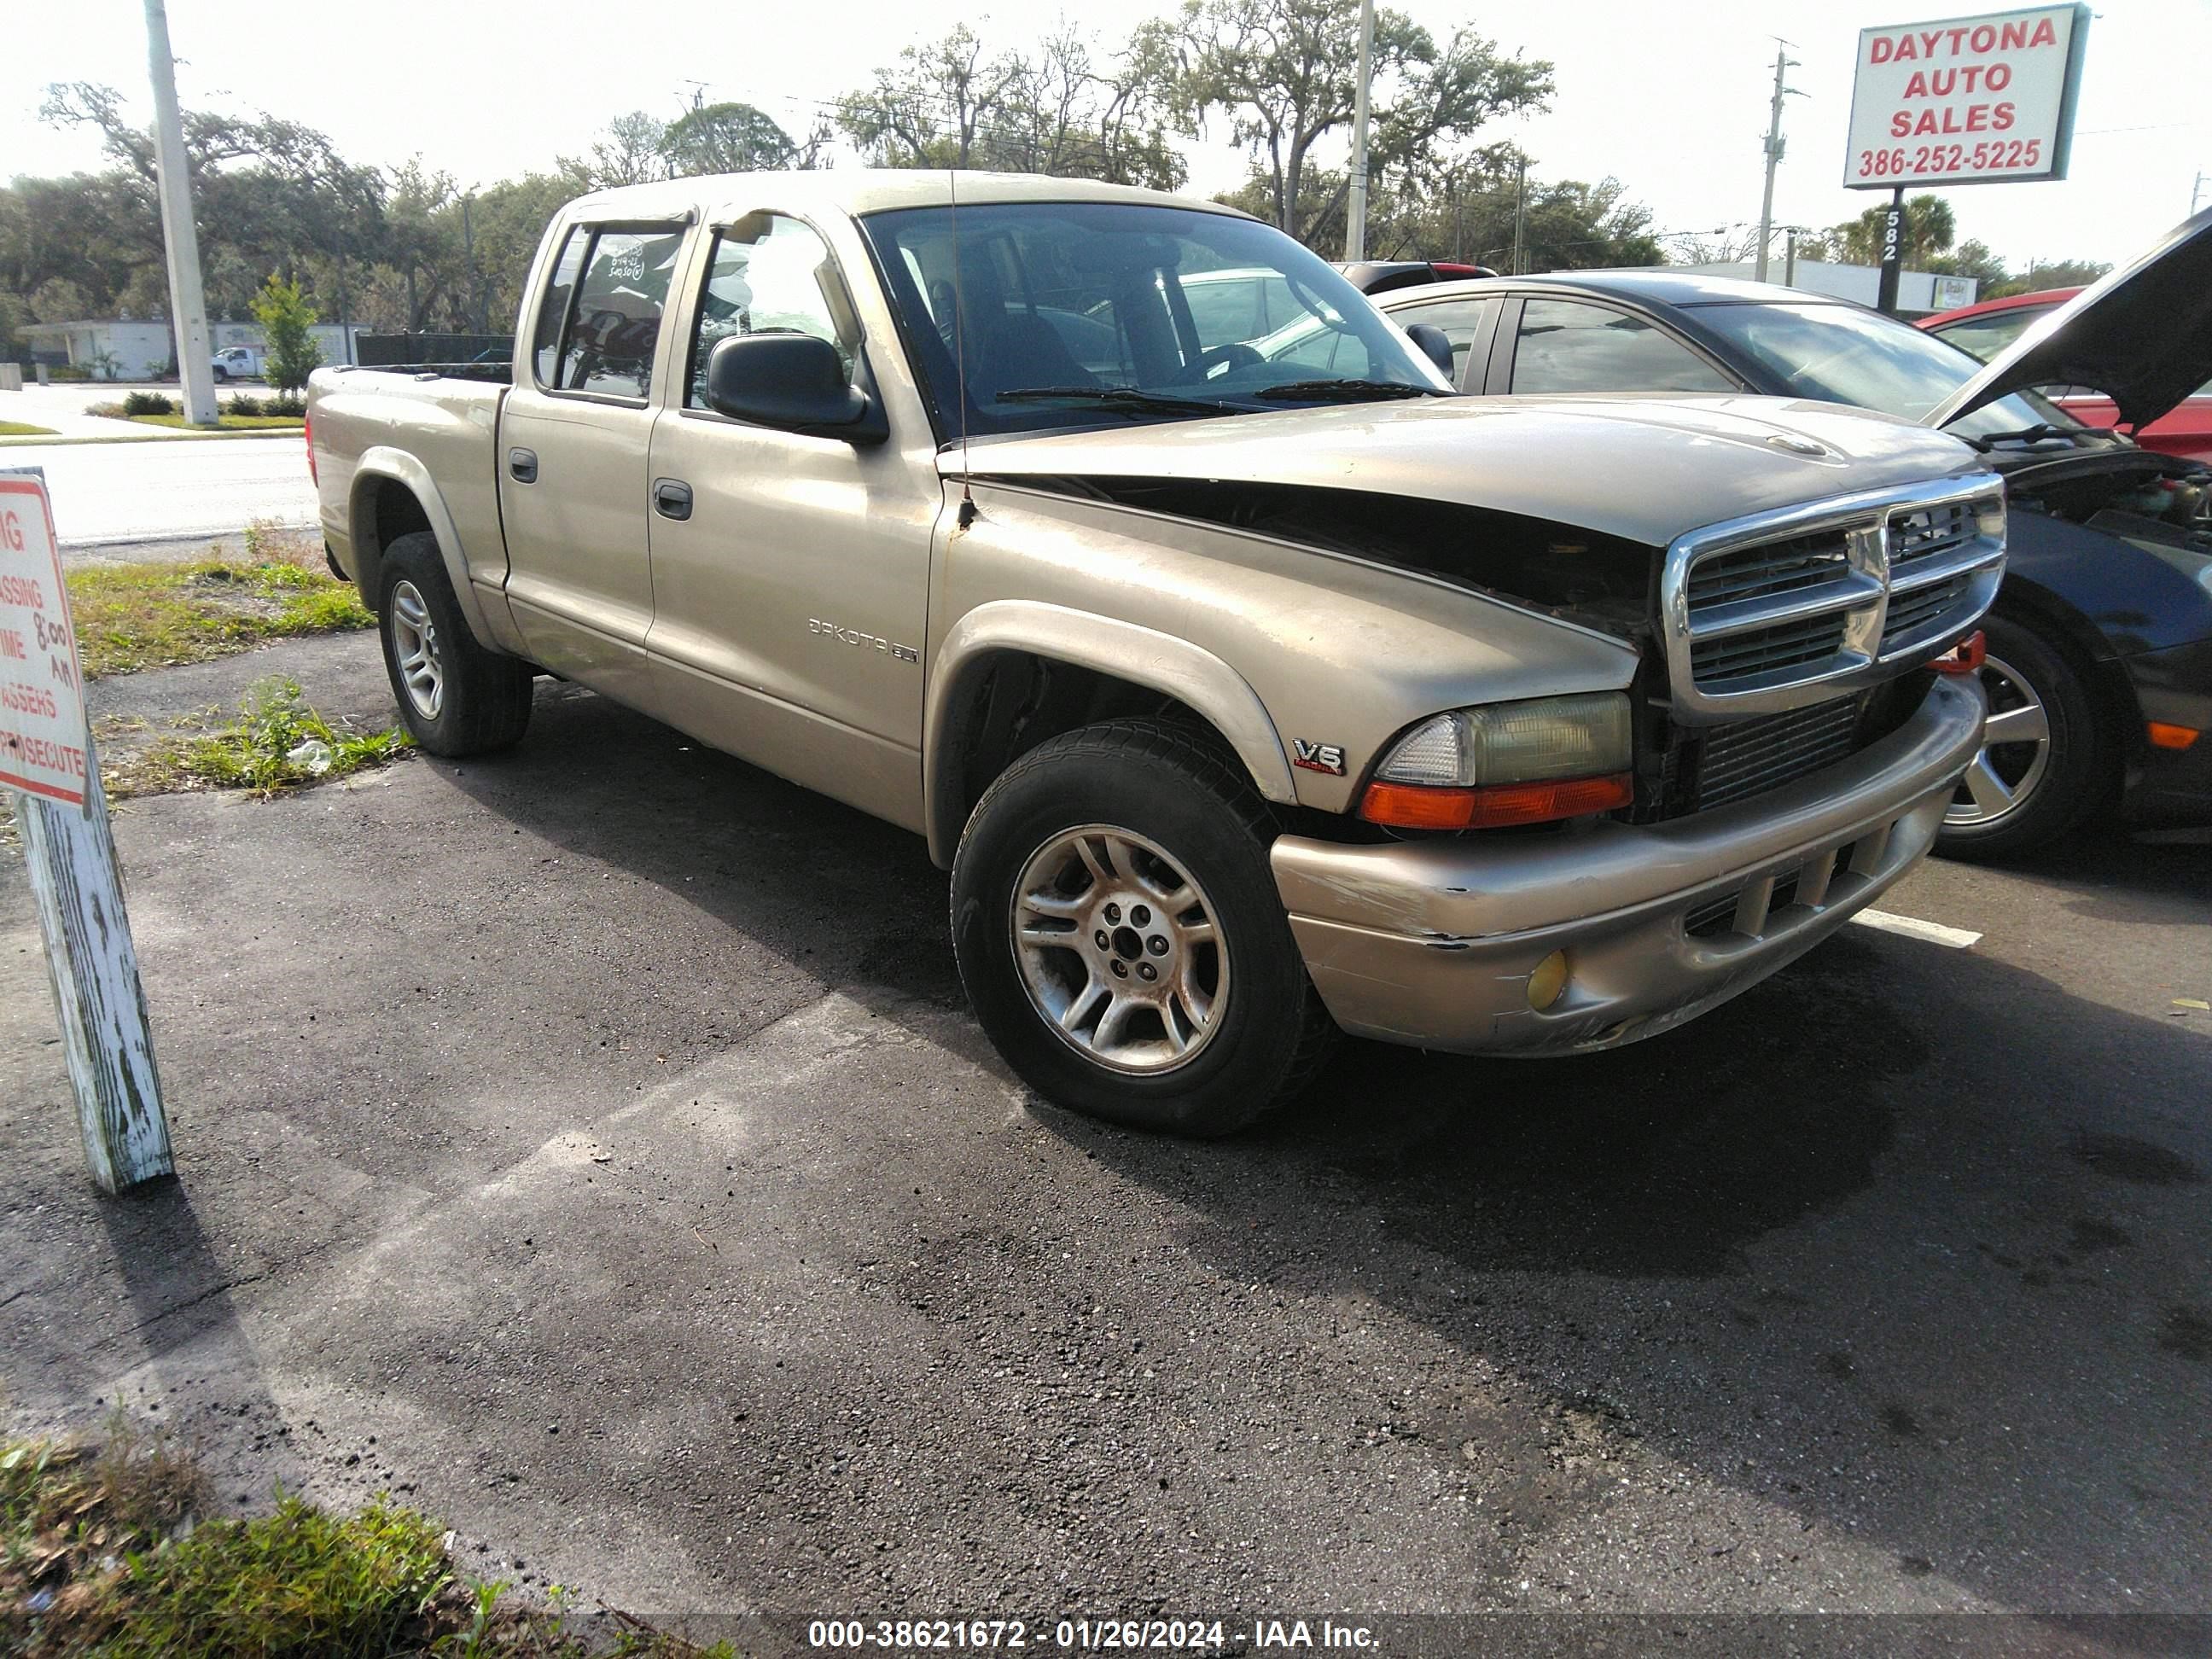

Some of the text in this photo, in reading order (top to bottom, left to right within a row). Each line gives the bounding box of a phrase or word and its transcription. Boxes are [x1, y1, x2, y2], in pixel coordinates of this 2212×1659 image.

[1870, 17, 2057, 64] DAYTONA
[1903, 62, 2012, 99] AUTO
[1890, 102, 2016, 138] SALES
[1859, 138, 2041, 177] 386-252-5225
[0, 628, 27, 660] IME
[808, 618, 888, 655] DAKOTA
[50, 654, 74, 690] AM
[1292, 738, 1342, 769] V6
